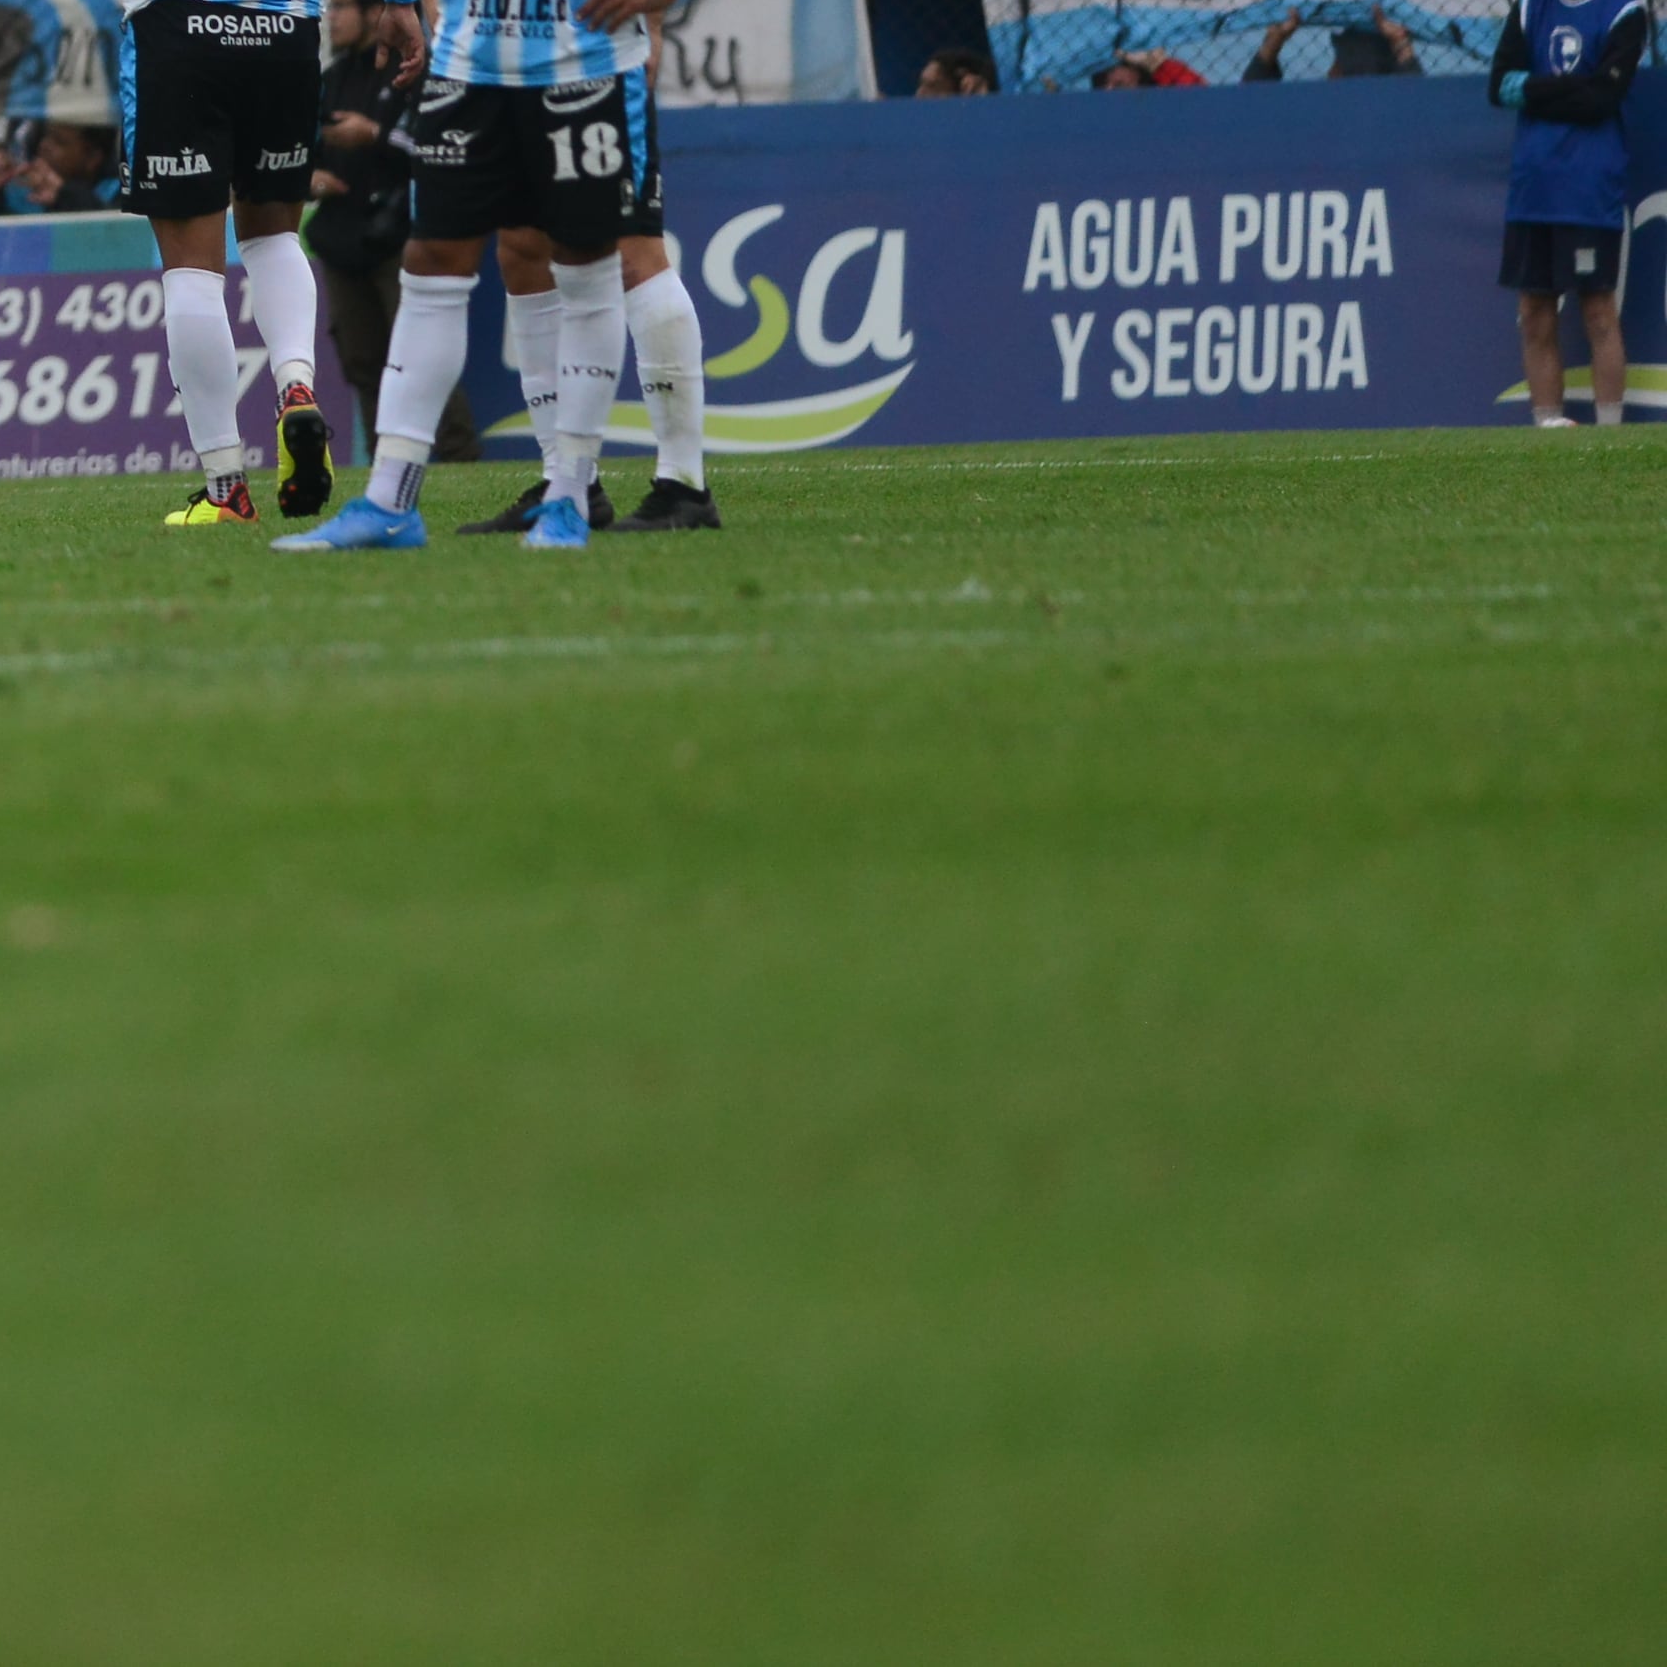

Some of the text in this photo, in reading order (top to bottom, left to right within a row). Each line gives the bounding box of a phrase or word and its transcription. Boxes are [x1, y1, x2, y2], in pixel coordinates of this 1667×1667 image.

[187, 15, 295, 35] ROSARIO
[220, 34, 271, 46] chateau
[255, 148, 309, 171] JULIA
[547, 122, 623, 180] 18
[147, 152, 212, 179] JULIA
[1023, 188, 1394, 292] AGUA PURA
[1051, 301, 1368, 401] Y SEGURA
[563, 365, 616, 381] LYON
[124, 443, 163, 473] de
